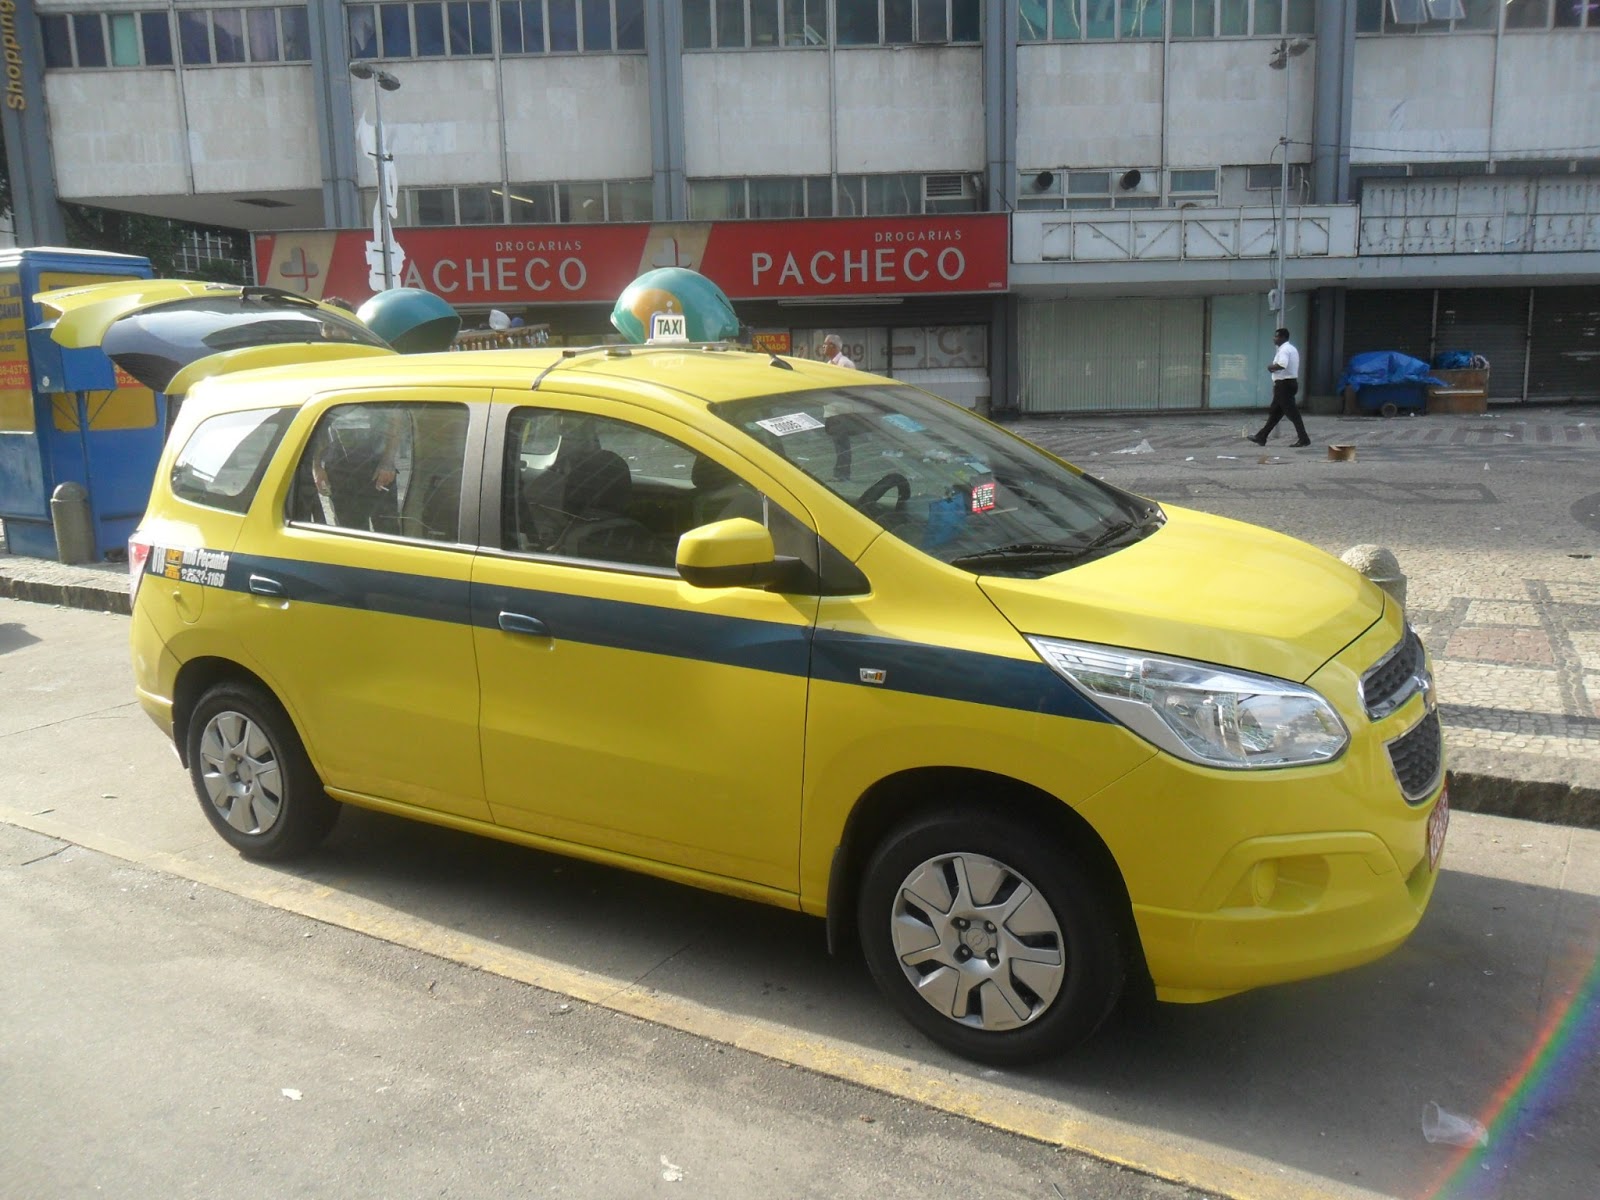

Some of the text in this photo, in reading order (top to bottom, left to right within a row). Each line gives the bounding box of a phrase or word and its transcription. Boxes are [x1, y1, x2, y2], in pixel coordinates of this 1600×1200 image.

[0, 0, 26, 110] Shopping
[495, 240, 583, 252] DROGARIAS
[875, 229, 963, 242] DROGARIAS
[404, 258, 588, 292] ACHECO
[750, 246, 966, 287] PACHECO
[657, 318, 683, 336] TAXI
